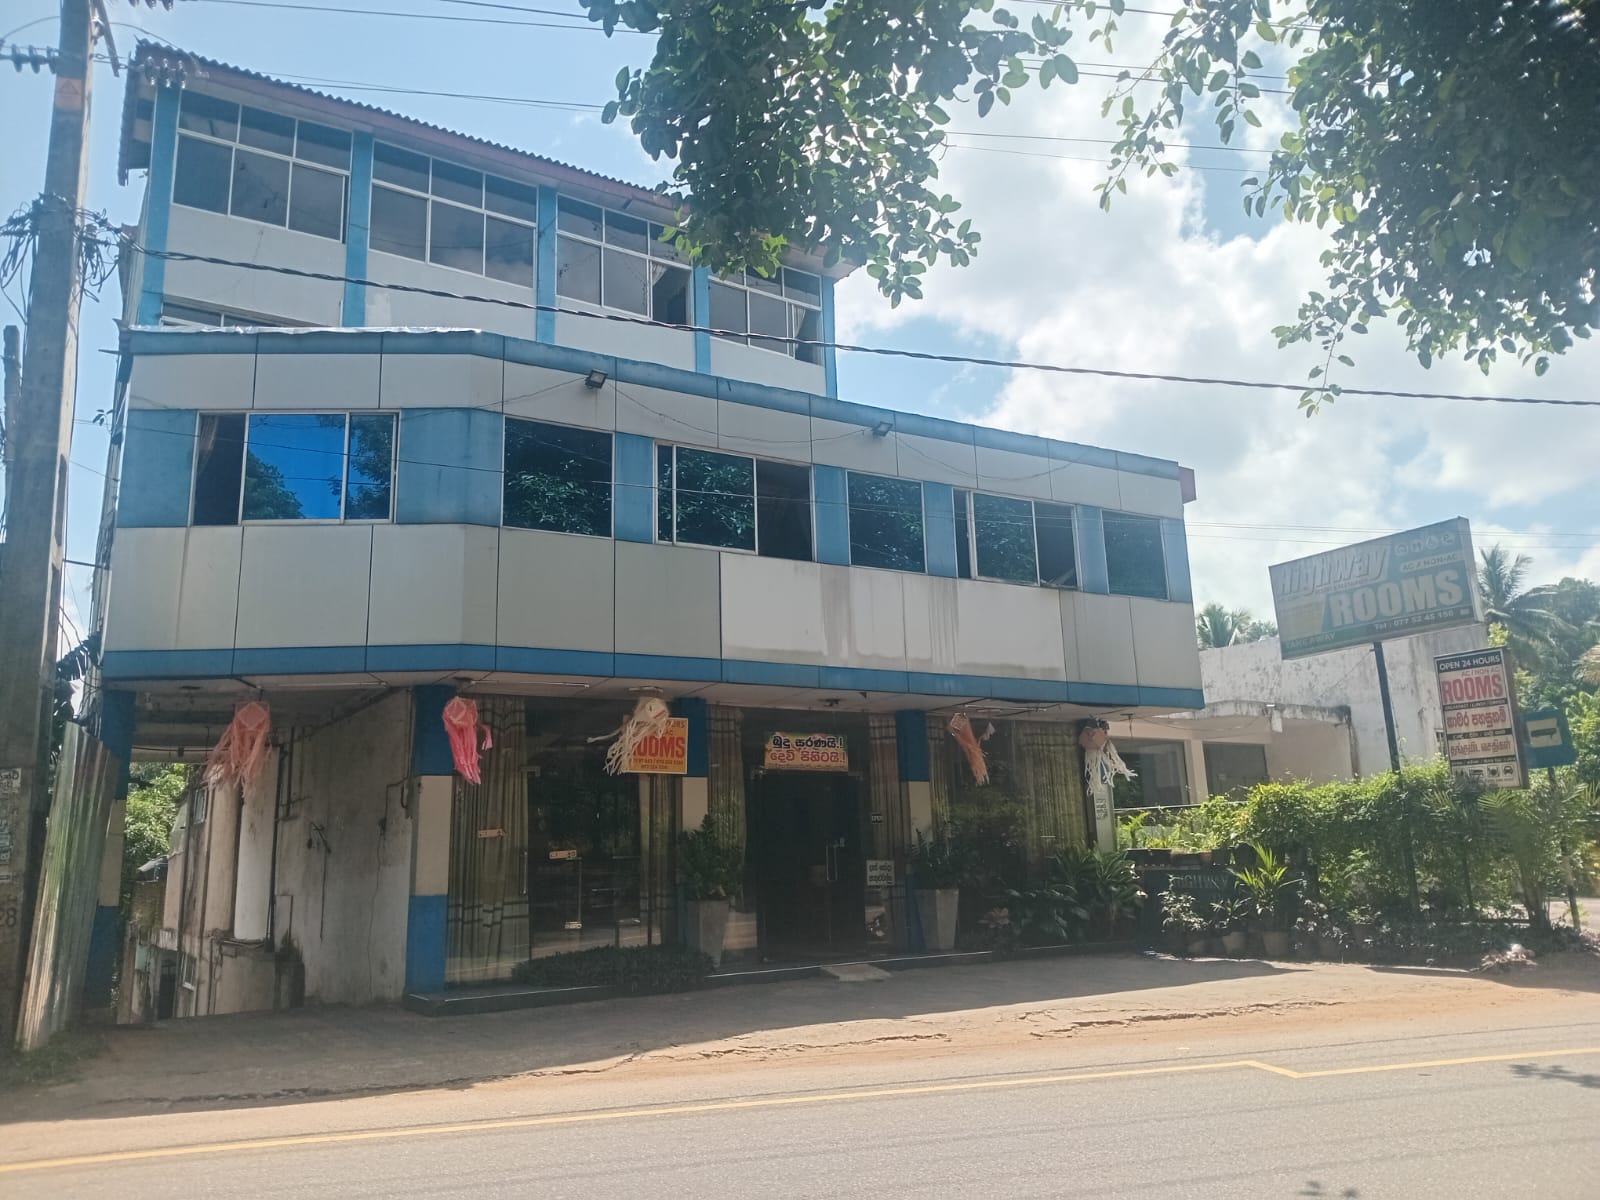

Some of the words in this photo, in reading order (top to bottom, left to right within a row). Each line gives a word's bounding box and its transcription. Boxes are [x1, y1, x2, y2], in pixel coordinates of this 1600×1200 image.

[1280, 545, 1391, 595] Highway
[1327, 569, 1463, 628] ROOMS
[1440, 661, 1460, 671] OPEN
[1462, 659, 1471, 668] 24
[1472, 654, 1500, 665] HOURS
[1441, 674, 1503, 704] ROOMS
[632, 735, 686, 758] OOMS
[772, 736, 791, 749] බුදු
